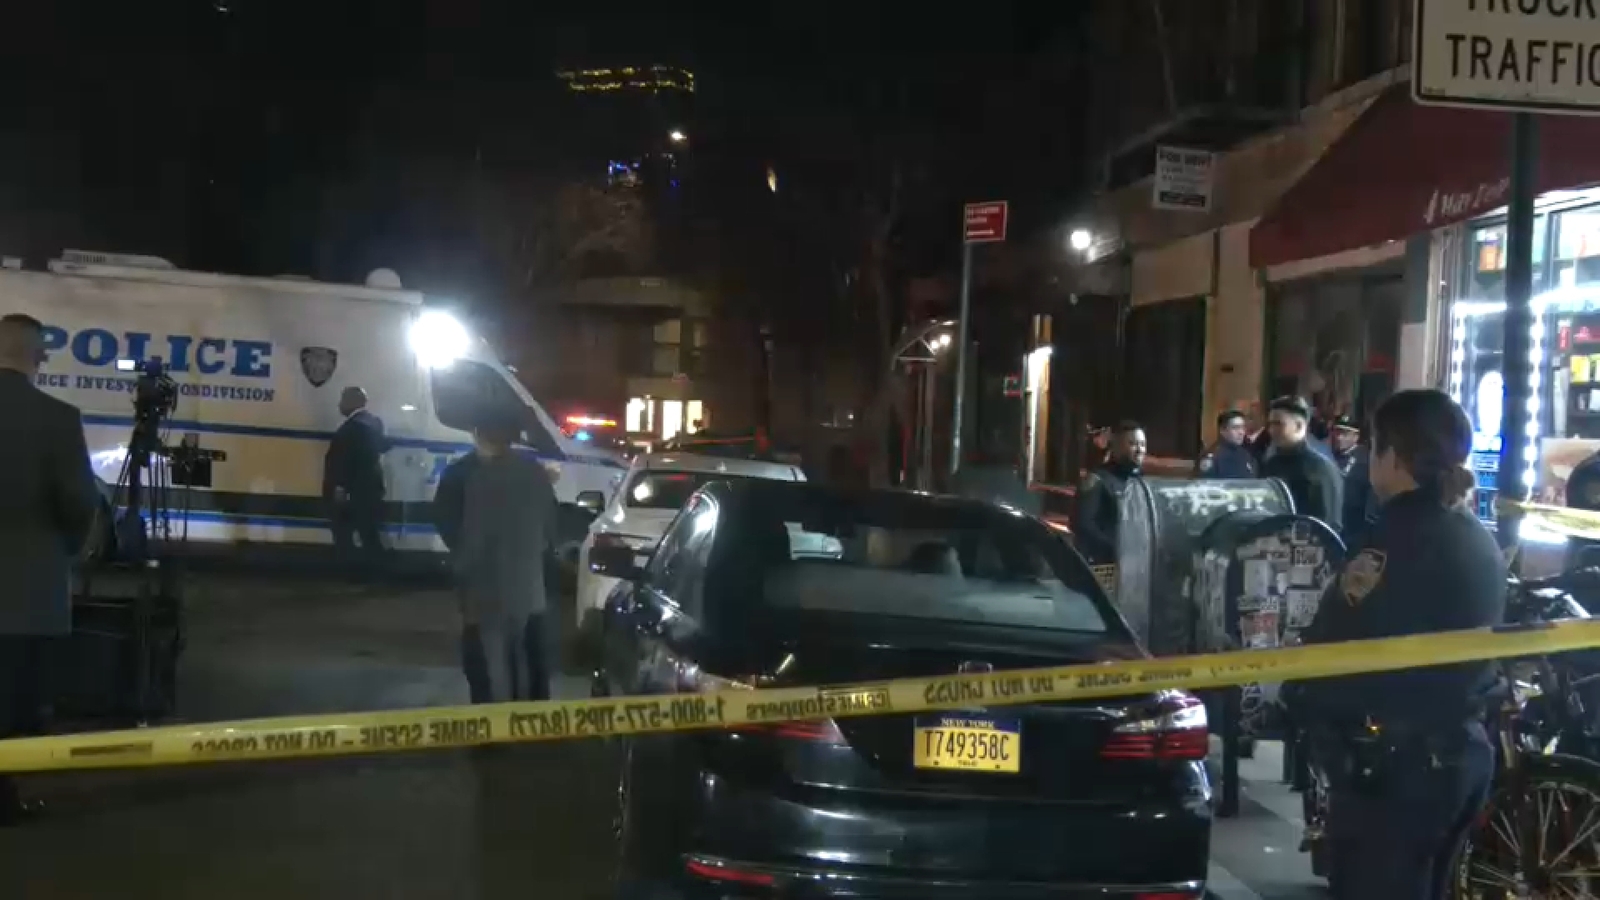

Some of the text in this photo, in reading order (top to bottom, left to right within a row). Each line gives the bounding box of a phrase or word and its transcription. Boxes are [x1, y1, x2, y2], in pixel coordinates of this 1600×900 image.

[37, 373, 69, 388] RCE
[941, 717, 995, 730] NEW YORK
[924, 730, 1010, 761] T749358C
